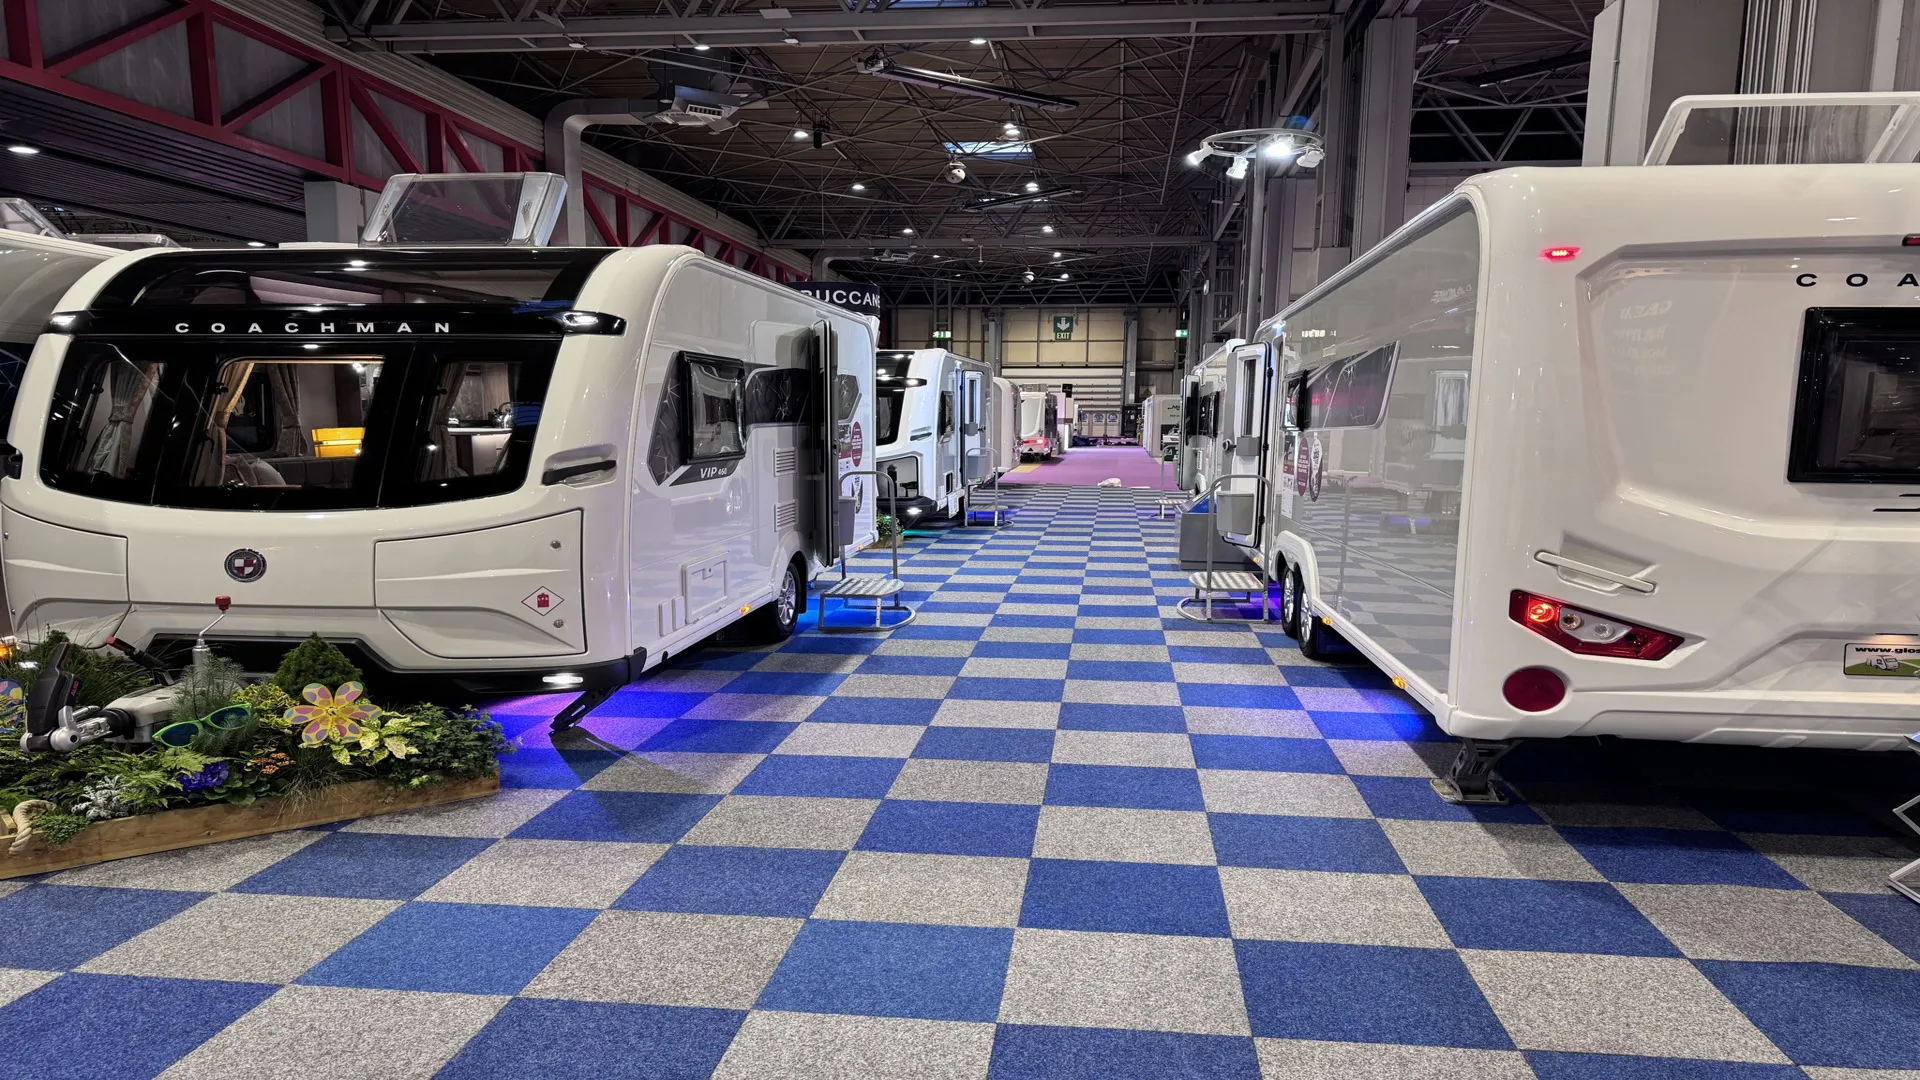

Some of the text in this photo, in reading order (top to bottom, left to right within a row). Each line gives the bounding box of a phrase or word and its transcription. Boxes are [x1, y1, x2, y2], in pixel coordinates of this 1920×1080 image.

[175, 322, 450, 333] COACHMAN
[1056, 332, 1071, 340] EXIT
[700, 466, 718, 479] VIP
